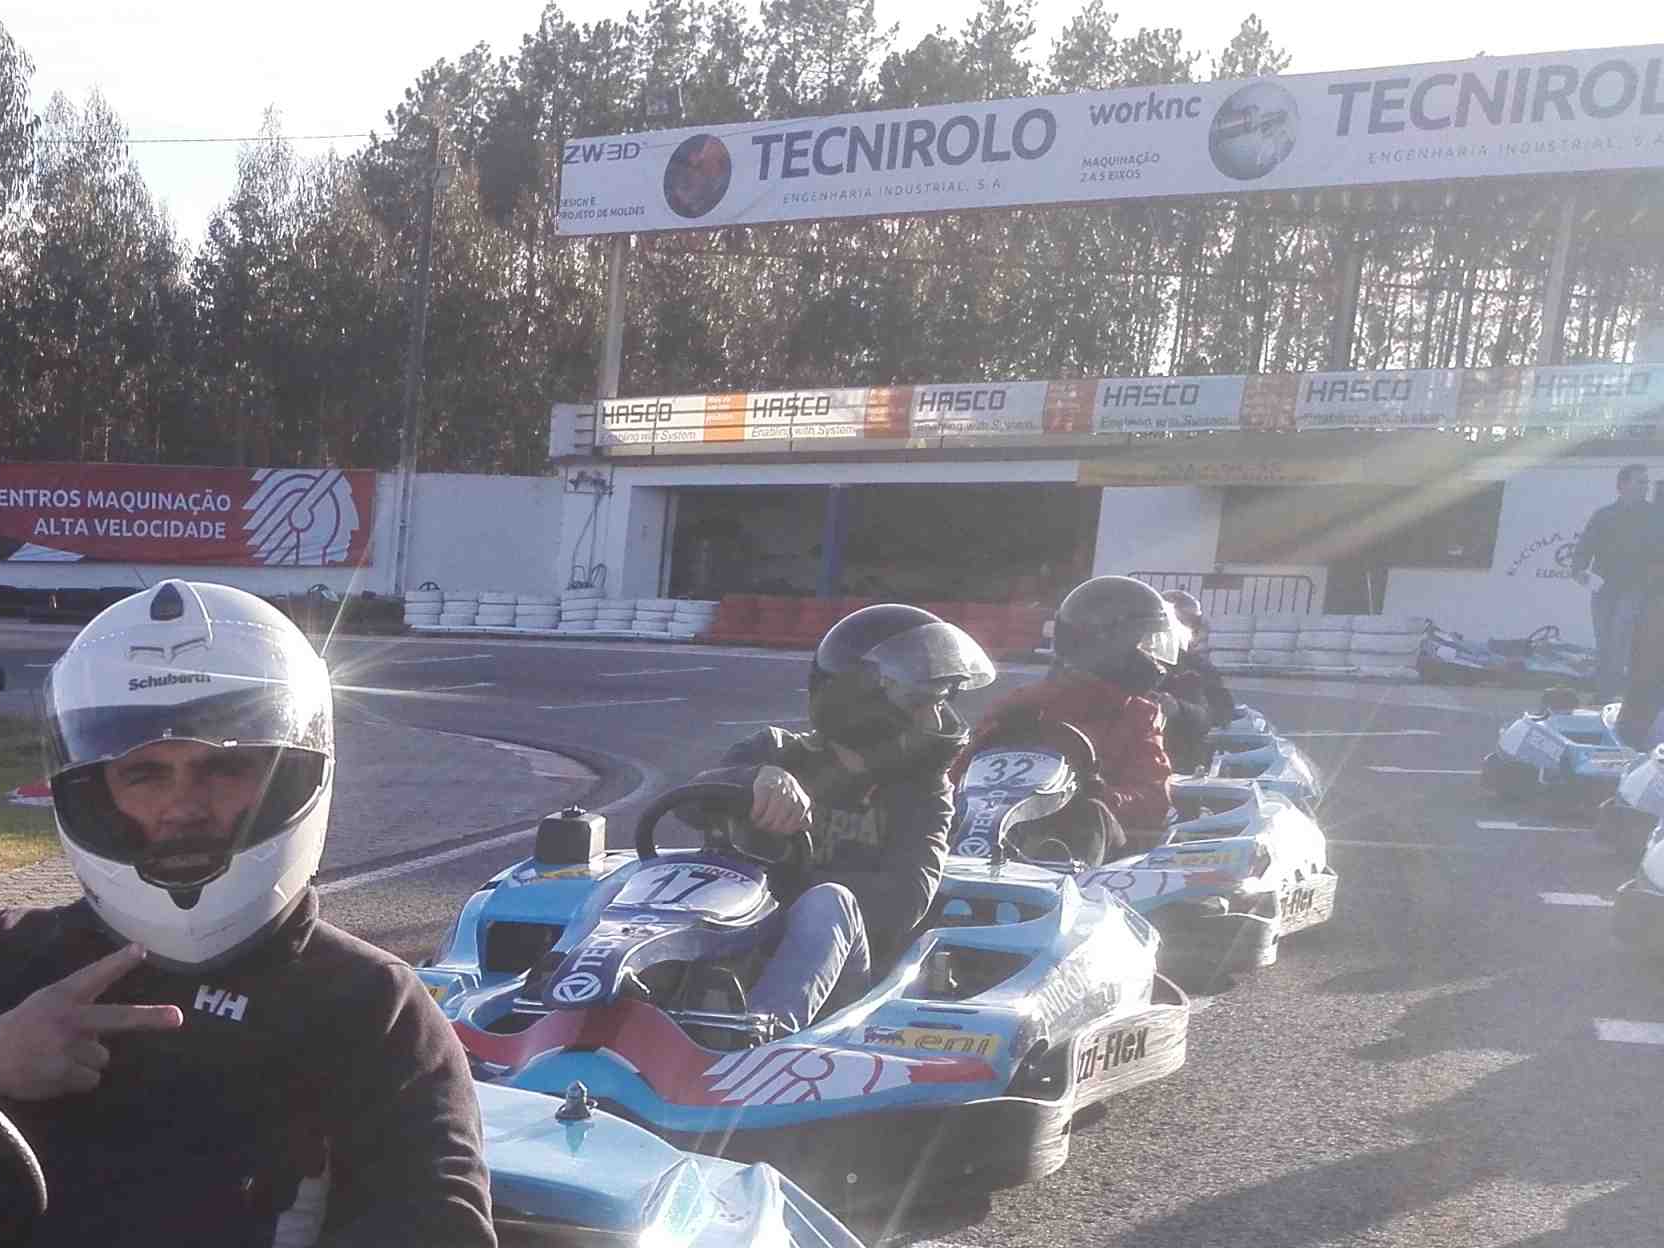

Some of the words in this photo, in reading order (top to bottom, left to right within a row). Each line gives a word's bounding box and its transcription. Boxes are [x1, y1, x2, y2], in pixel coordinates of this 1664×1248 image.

[563, 142, 641, 164] ZW3D
[751, 108, 1057, 181] TECNIROLO
[783, 190, 873, 204] ENGENHARIA
[918, 389, 1007, 412] HASCO
[1103, 384, 1200, 407] HASCO
[1306, 379, 1412, 402] HASCO
[602, 402, 672, 424] HASCO
[752, 396, 832, 418] HASCO
[87, 488, 232, 516] MAQUINAÇÃO
[34, 517, 88, 536] ALTA
[97, 518, 226, 540] VELOCIDADE
[983, 758, 1035, 784] 32
[644, 869, 721, 905] 17
[194, 984, 249, 1021] HH
[914, 1033, 993, 1056] eni
